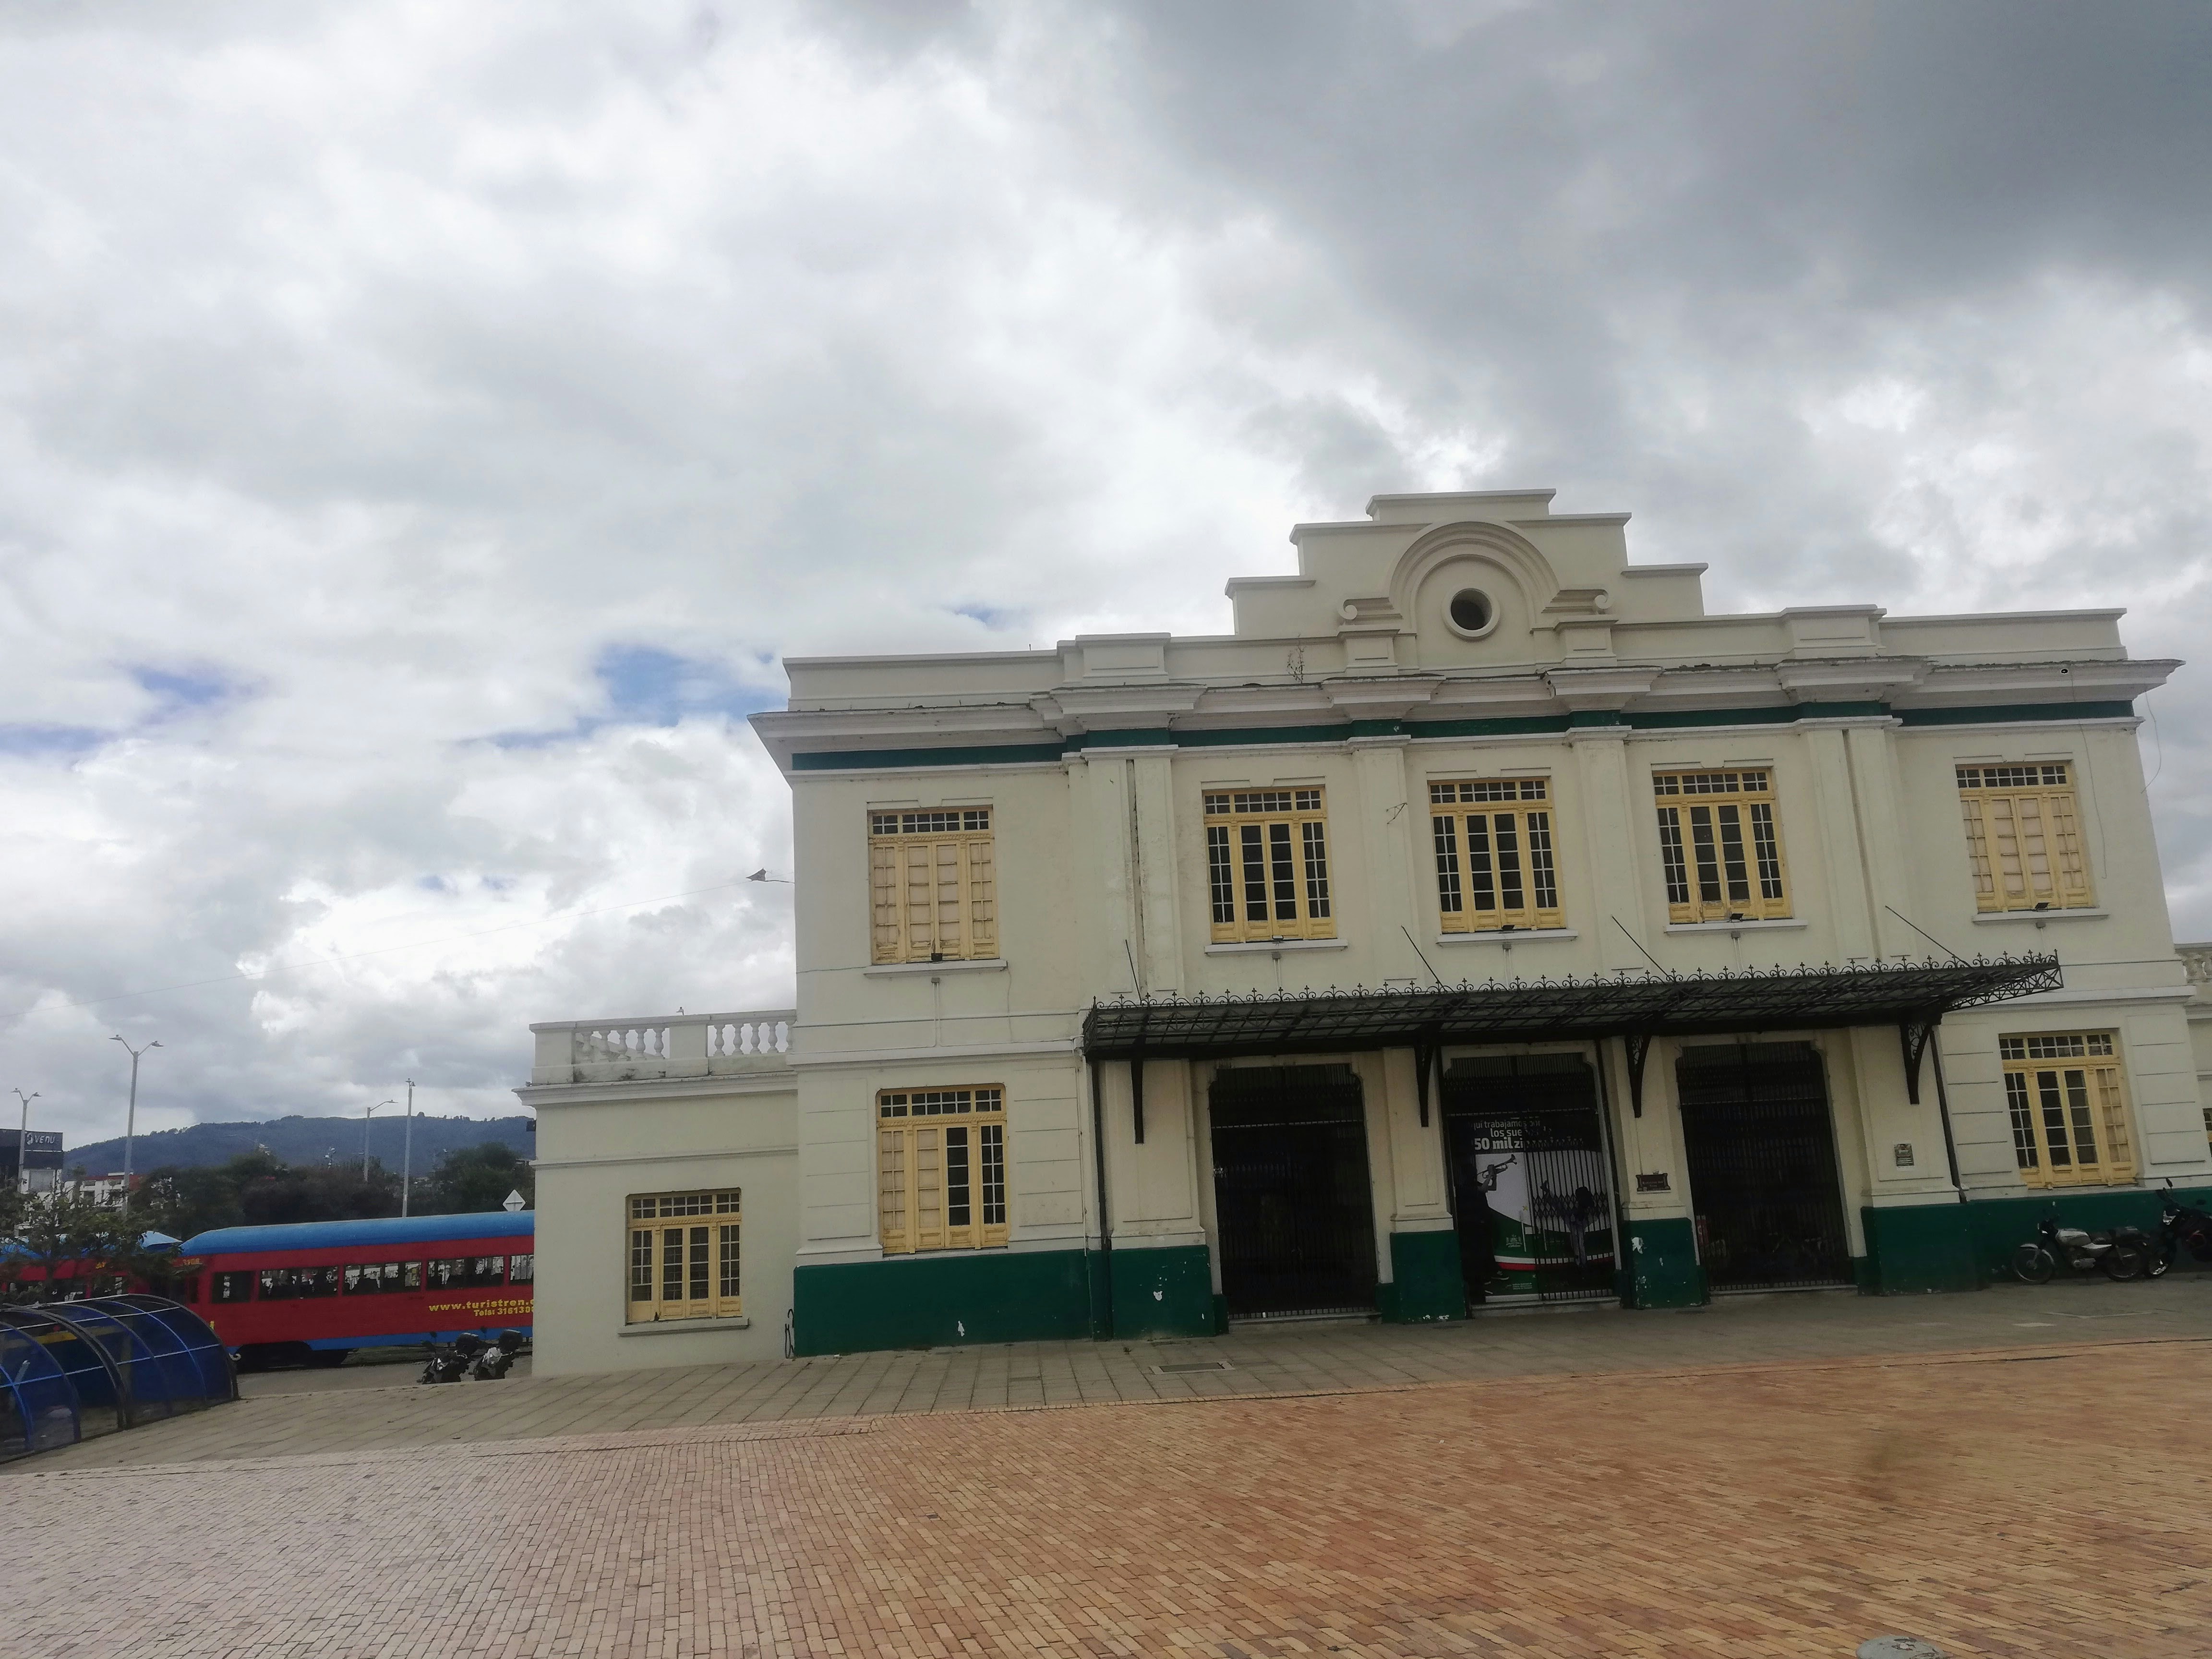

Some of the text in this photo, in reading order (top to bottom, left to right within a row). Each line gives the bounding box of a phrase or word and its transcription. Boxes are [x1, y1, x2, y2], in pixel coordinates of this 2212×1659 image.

[1484, 1119, 1527, 1130] trabajamos
[1491, 1128, 1504, 1137] los
[1474, 1137, 1490, 1150] 50
[1492, 1136, 1513, 1150] mil
